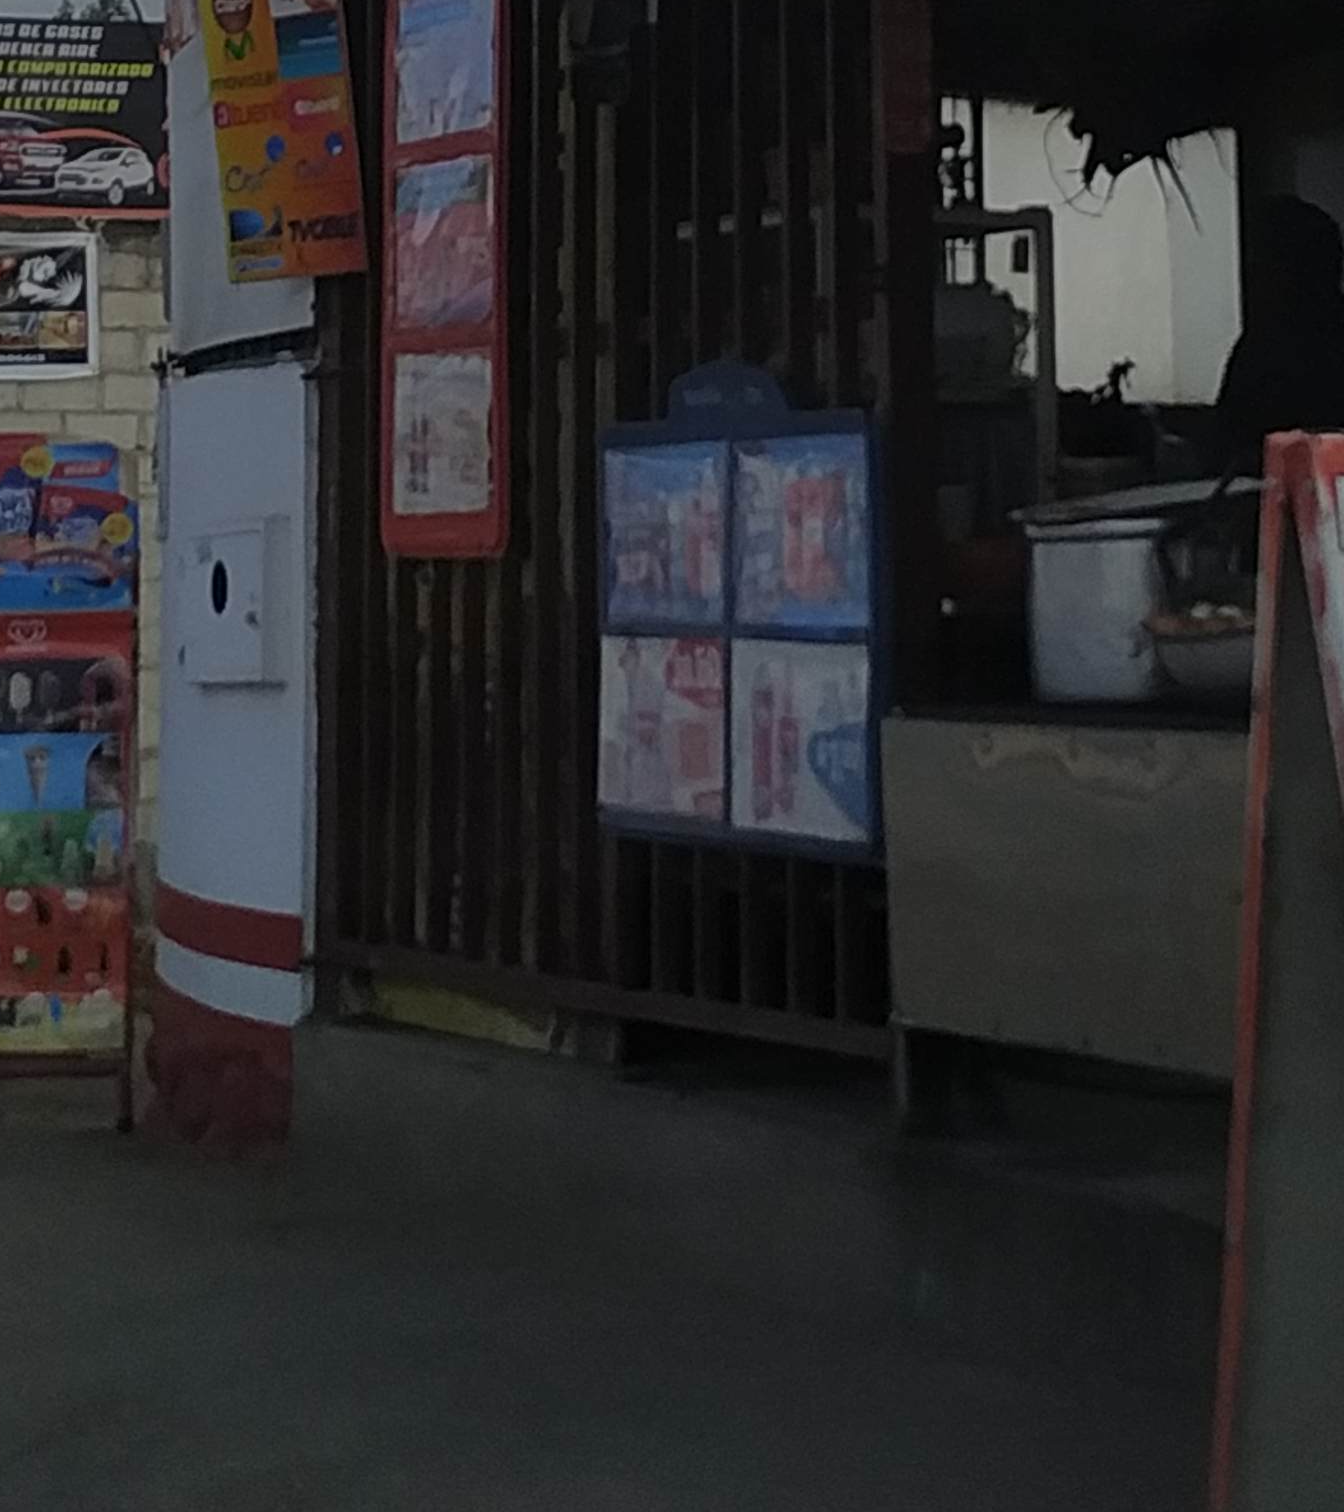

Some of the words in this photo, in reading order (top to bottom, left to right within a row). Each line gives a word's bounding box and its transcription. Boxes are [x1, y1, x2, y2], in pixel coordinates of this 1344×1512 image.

[18, 23, 42, 38] DE
[44, 24, 105, 41] GASES
[20, 78, 130, 96] INYECTORES
[3, 96, 121, 114] ELECTRONICO
